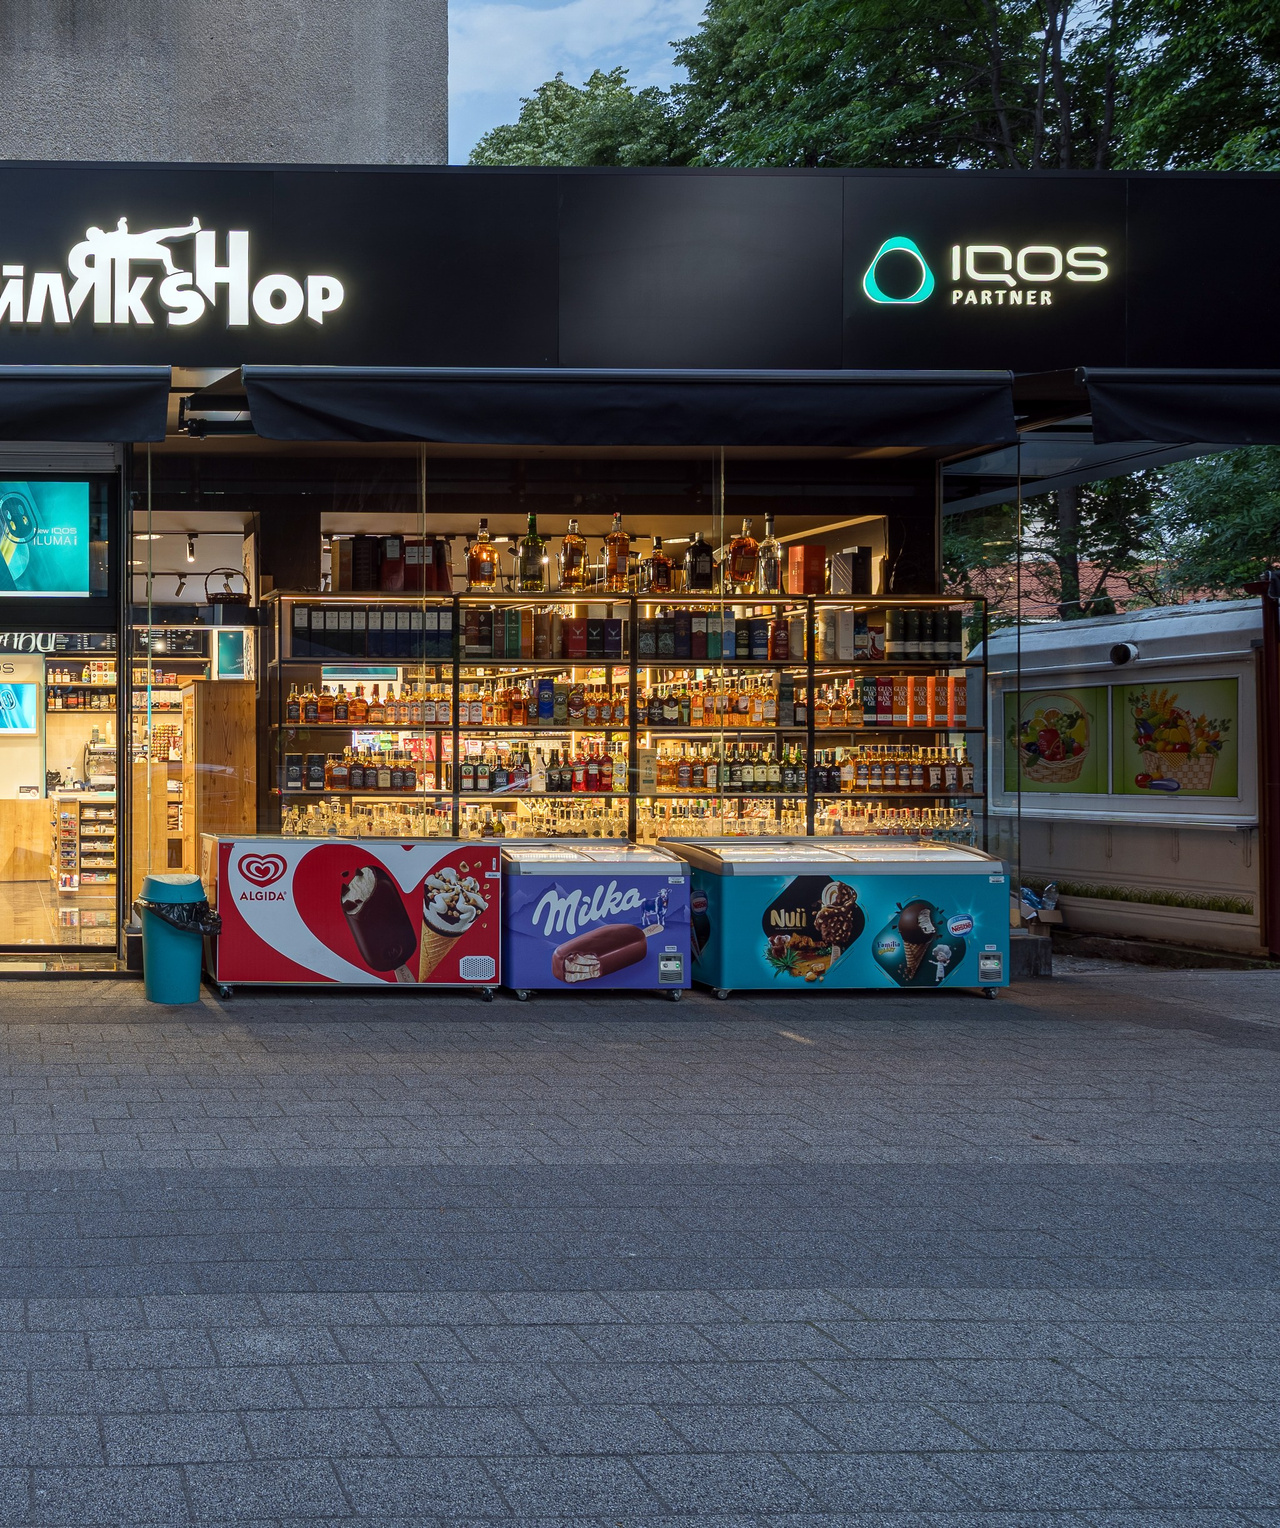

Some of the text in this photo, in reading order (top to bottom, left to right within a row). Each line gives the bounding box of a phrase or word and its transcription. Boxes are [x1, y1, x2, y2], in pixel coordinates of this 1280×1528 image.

[952, 245, 1109, 287] IQOS
[952, 290, 1052, 305] PARTNER
[51, 527, 77, 535] IQOS
[33, 535, 70, 546] ILUMA
[532, 880, 646, 936] Milka
